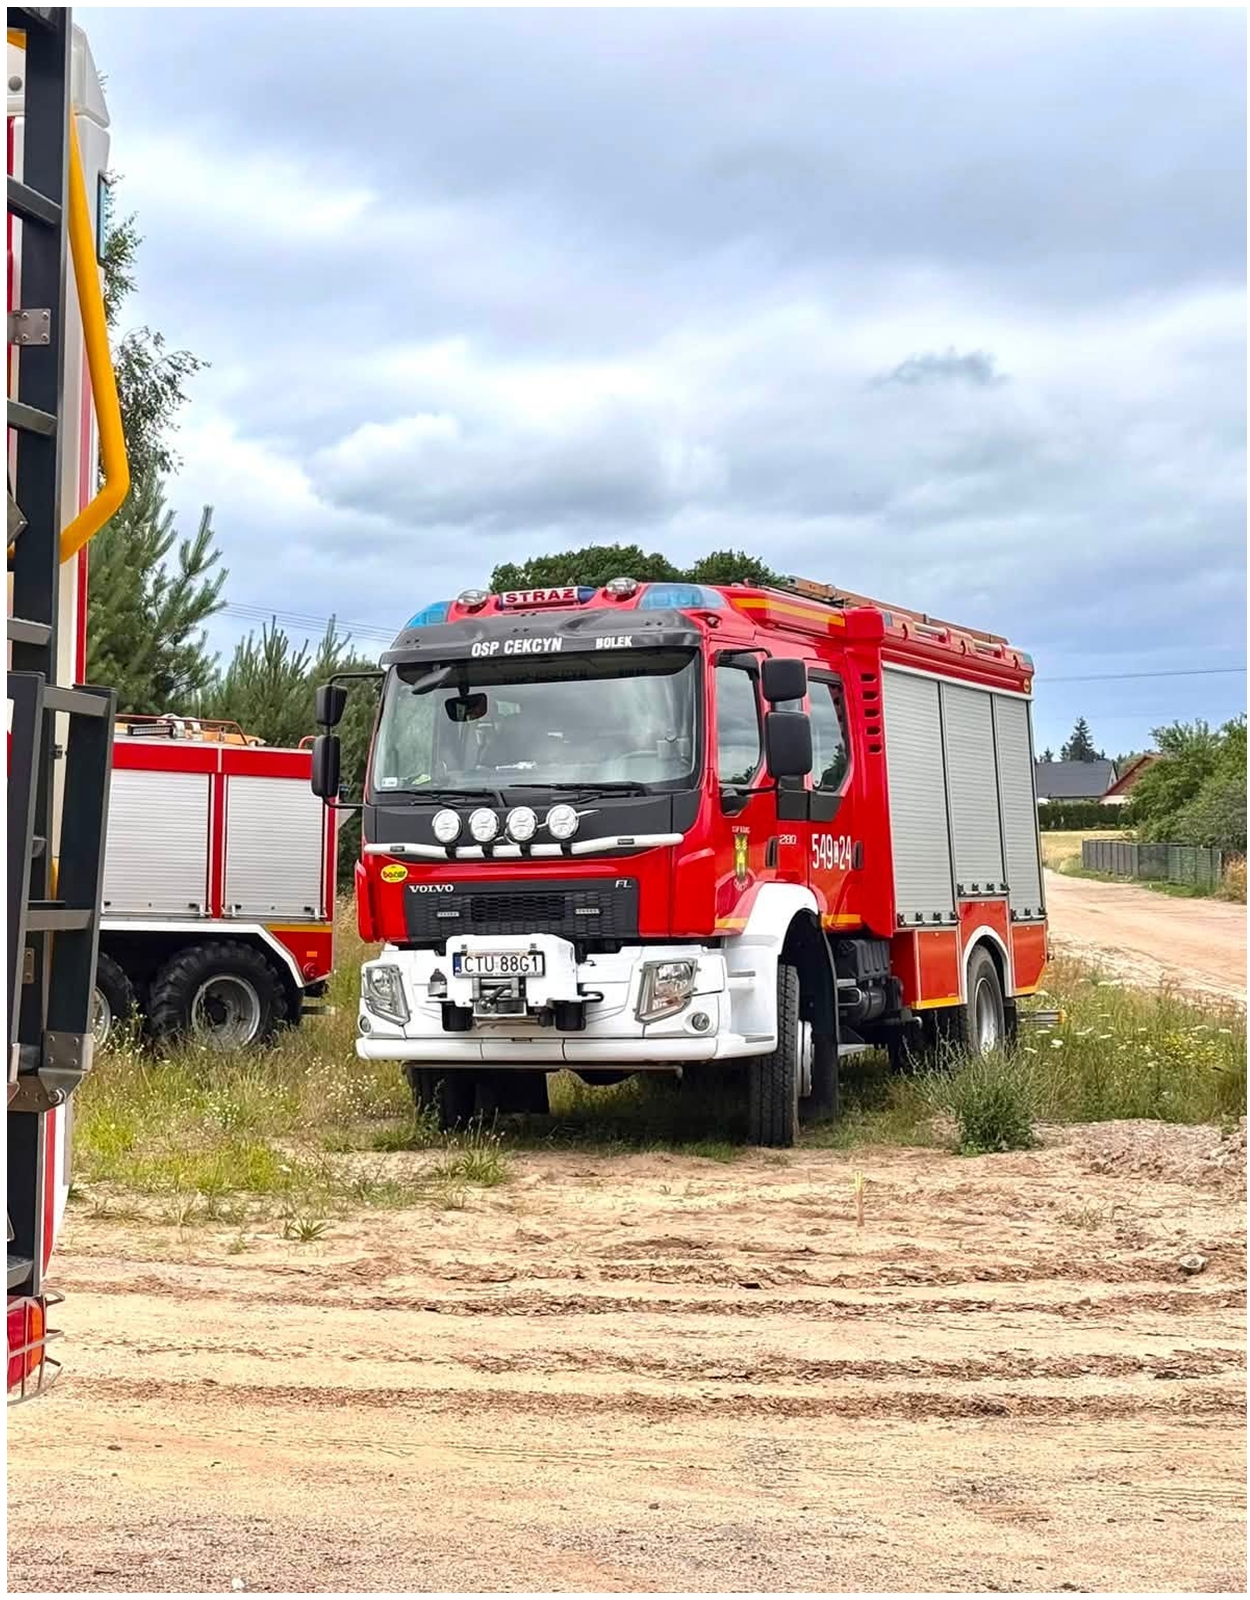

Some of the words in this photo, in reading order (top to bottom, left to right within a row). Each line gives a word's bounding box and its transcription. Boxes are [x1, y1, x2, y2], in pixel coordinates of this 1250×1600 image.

[471, 641, 500, 657] OSP
[504, 637, 563, 654] CEKCYN
[595, 635, 633, 649] BOLEK
[408, 884, 455, 893] VOLVO
[614, 879, 632, 889] FL
[464, 956, 494, 973] CTU
[500, 955, 538, 973] 88G1
